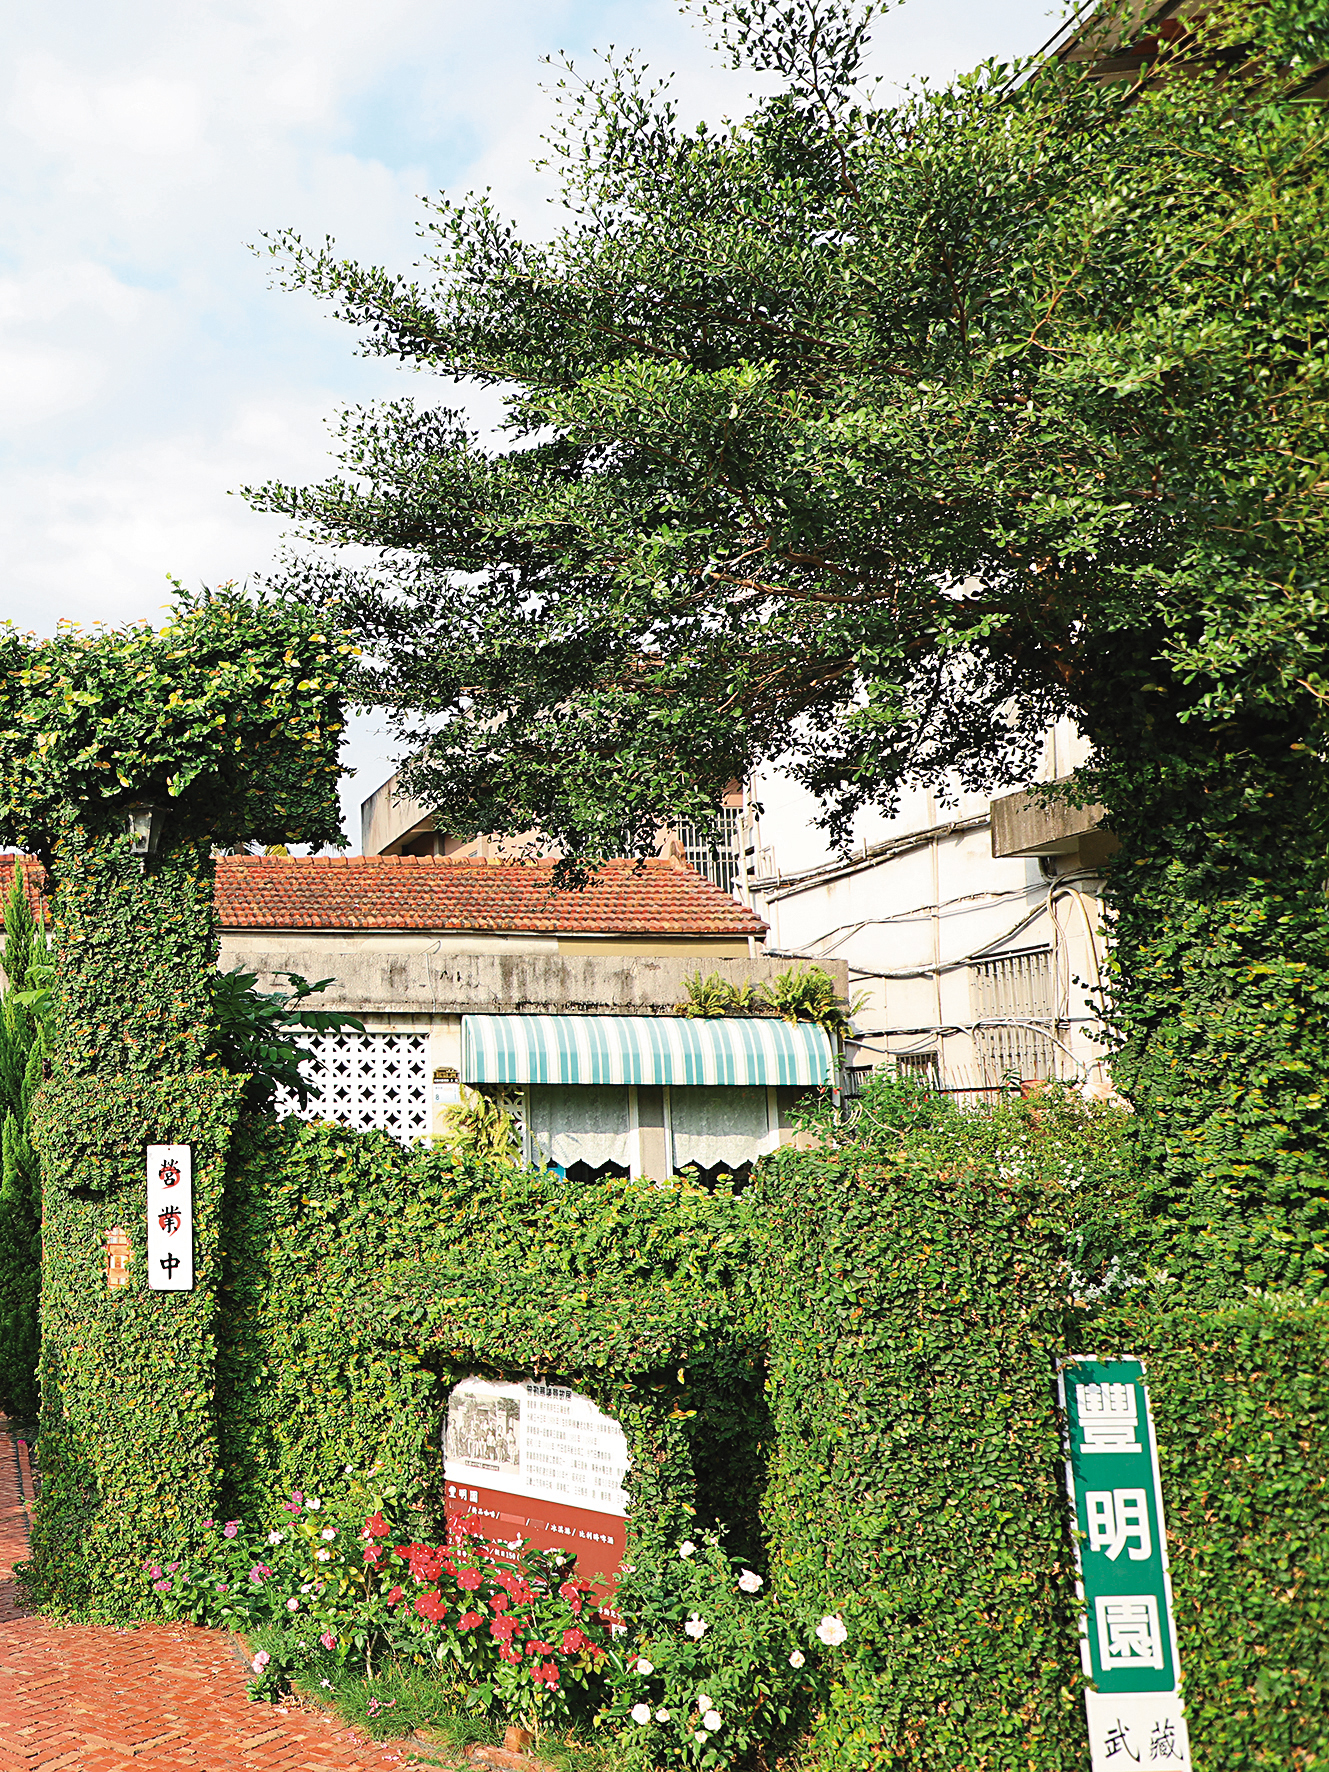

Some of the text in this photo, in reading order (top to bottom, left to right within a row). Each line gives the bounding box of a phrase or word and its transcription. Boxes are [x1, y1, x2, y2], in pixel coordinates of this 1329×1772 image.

[158, 1158, 181, 1280] 營業中
[1075, 1381, 1165, 1672] 豐明園
[1104, 1717, 1183, 1763] 武藏
